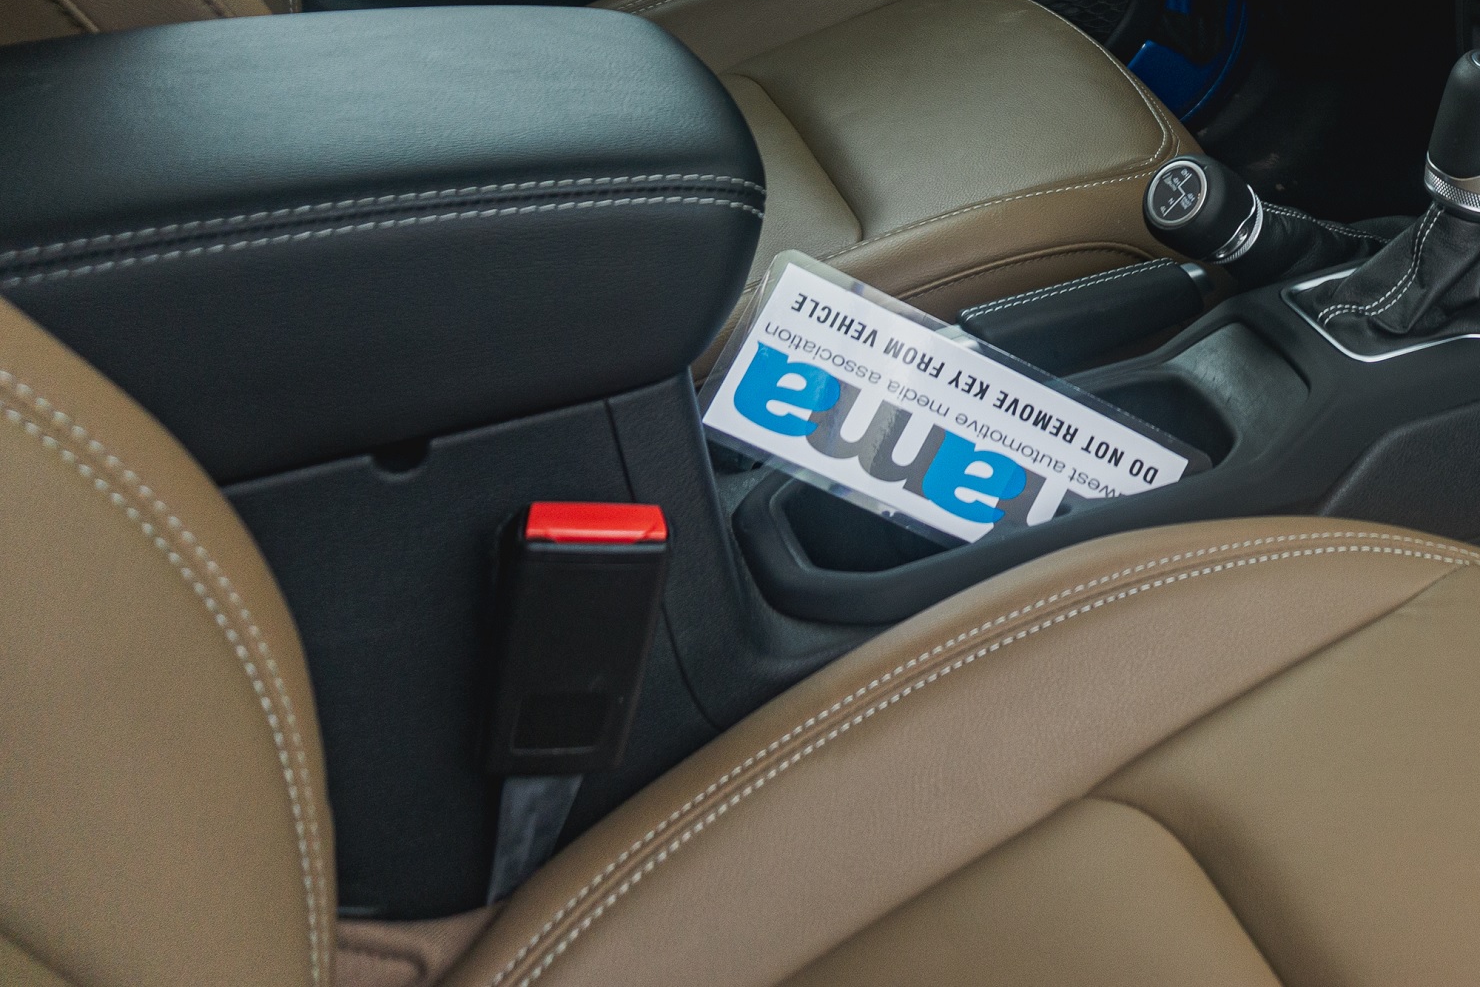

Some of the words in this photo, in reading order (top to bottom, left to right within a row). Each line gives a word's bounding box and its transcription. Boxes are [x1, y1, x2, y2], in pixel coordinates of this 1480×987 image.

[791, 292, 879, 348] VEHICLE
[765, 320, 882, 385] association
[883, 337, 946, 379] FROM
[887, 378, 950, 415] media
[948, 369, 991, 400] KEY
[992, 390, 1079, 444] REMOVE
[955, 412, 1067, 473] automotive
[1081, 434, 1125, 468] NOT
[1067, 470, 1124, 499] west
[1129, 458, 1159, 485] DO
